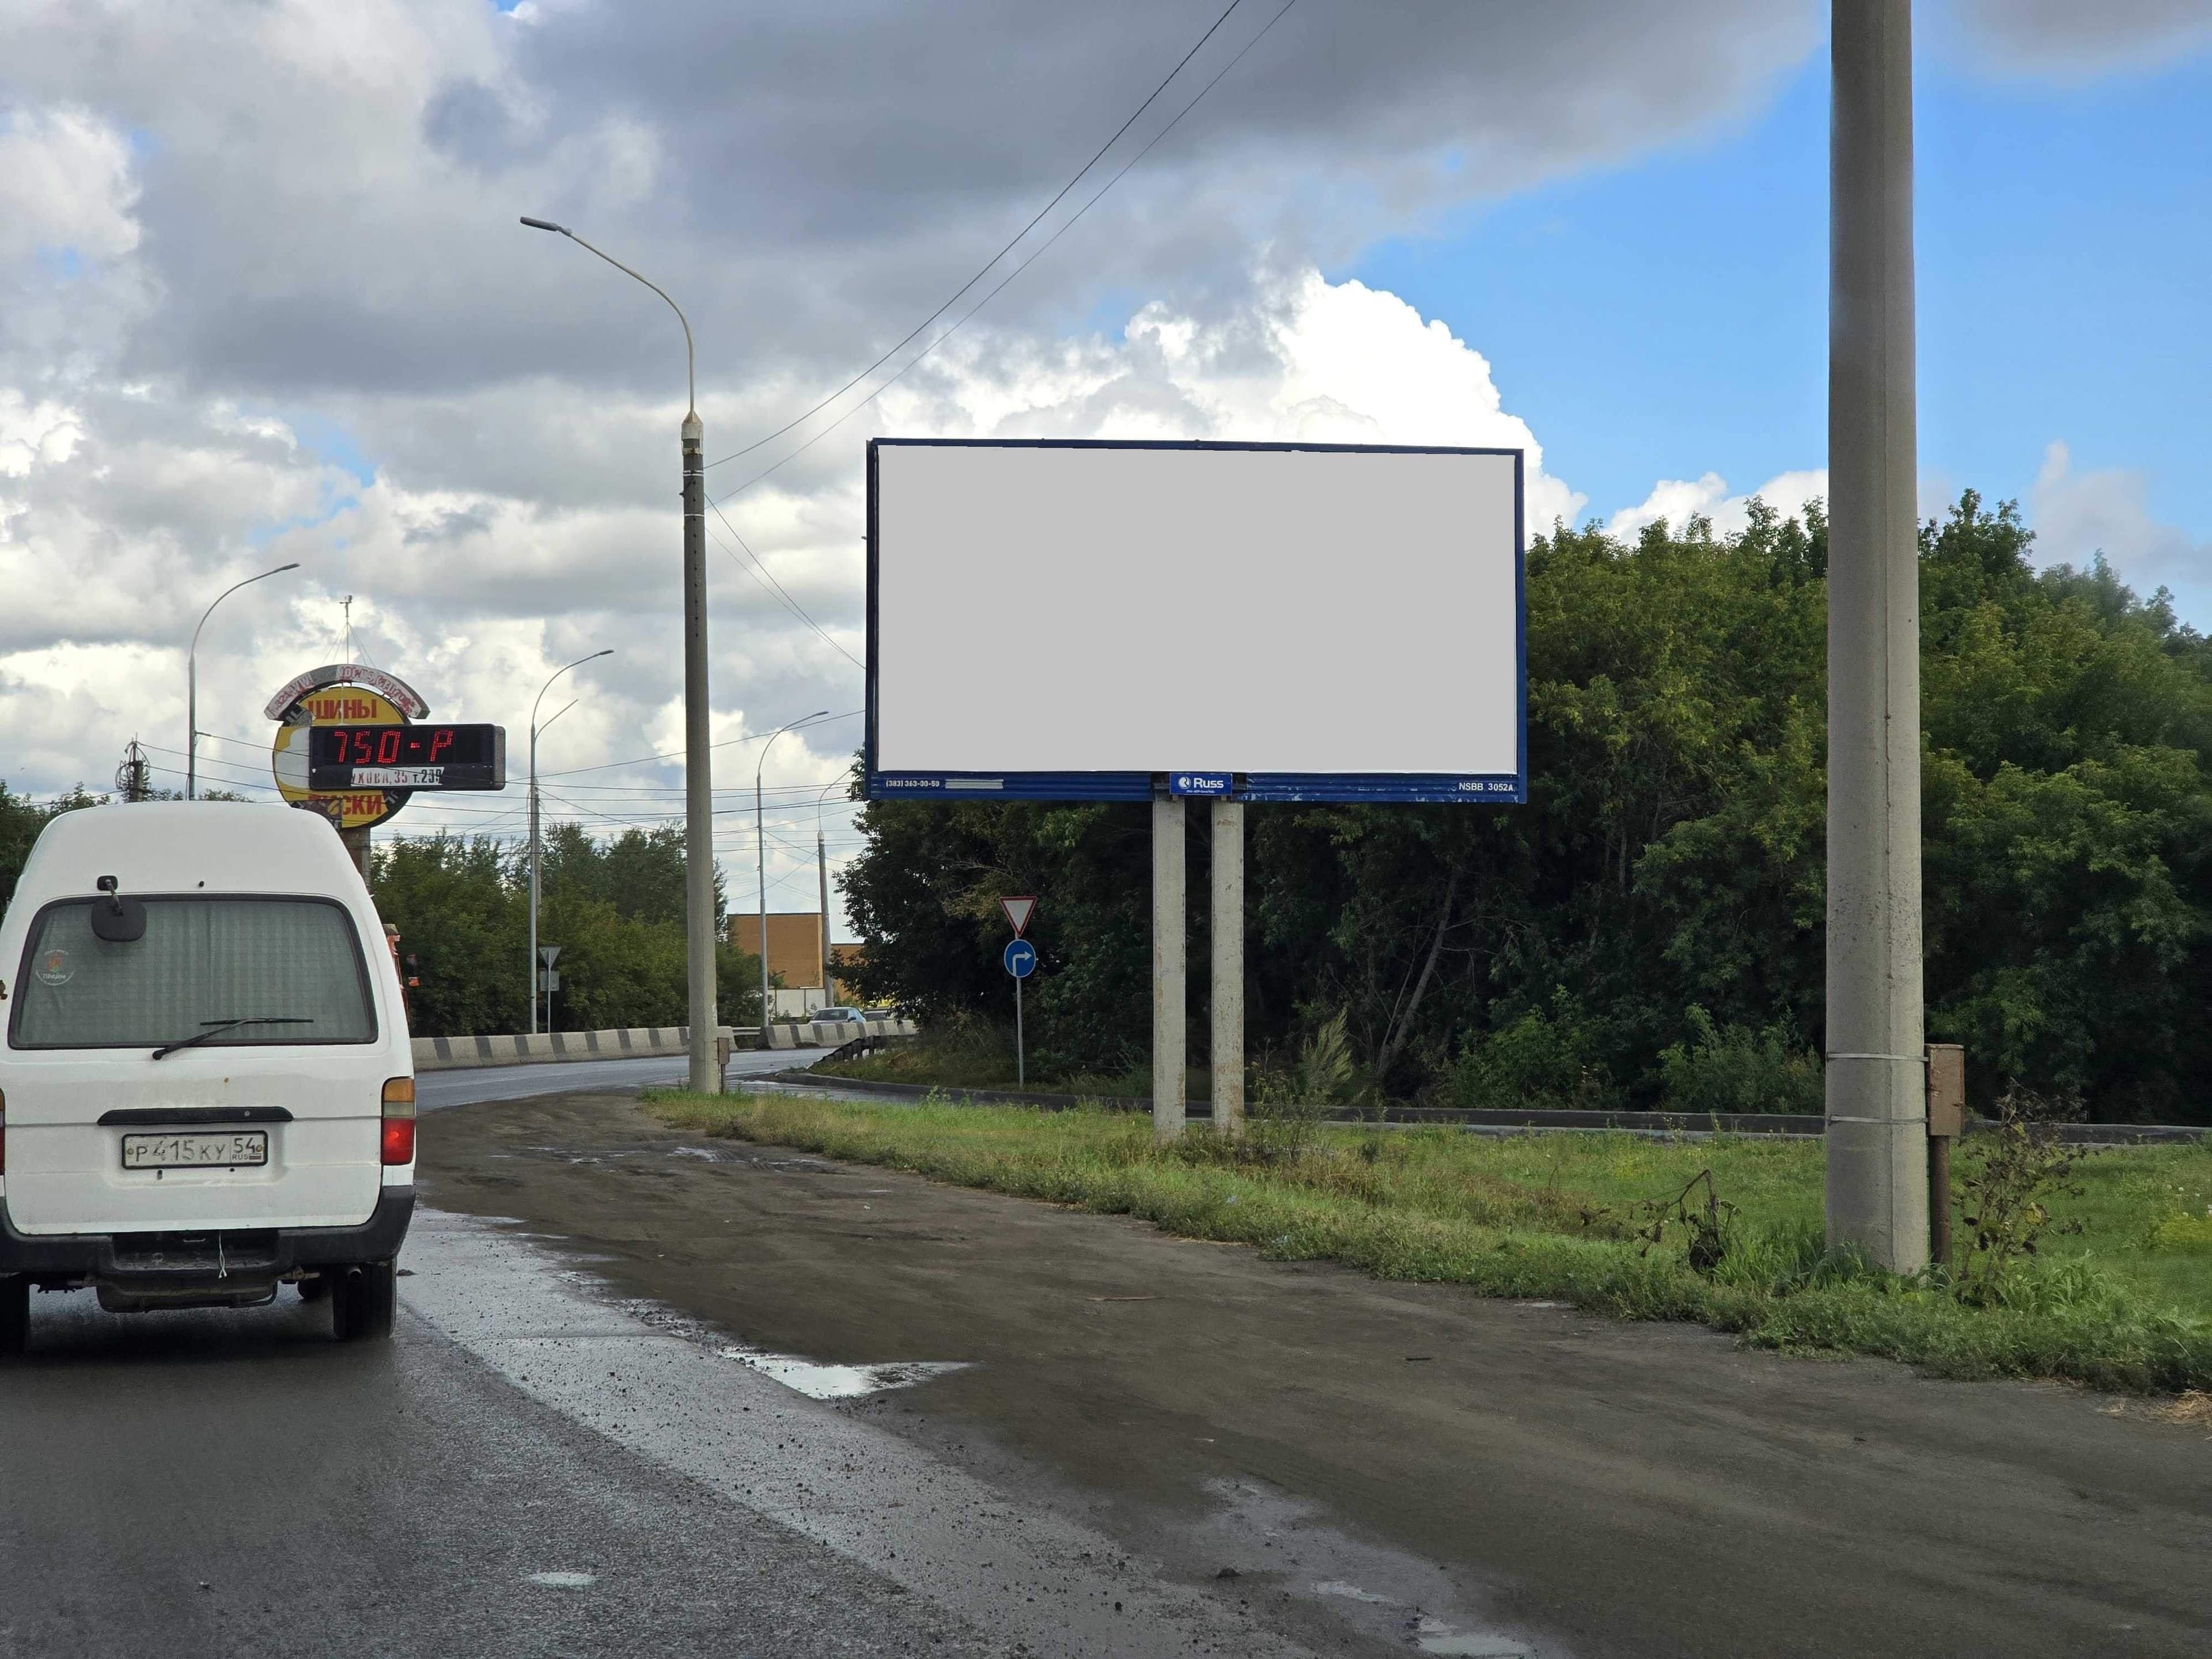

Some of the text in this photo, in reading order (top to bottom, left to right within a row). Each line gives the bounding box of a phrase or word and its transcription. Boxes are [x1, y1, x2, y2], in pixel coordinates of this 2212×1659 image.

[308, 699, 377, 719] ШИНЫ
[1194, 778, 1224, 789] Russ
[1459, 782, 1513, 791] NSBB 3052A
[233, 1137, 255, 1153] 54
